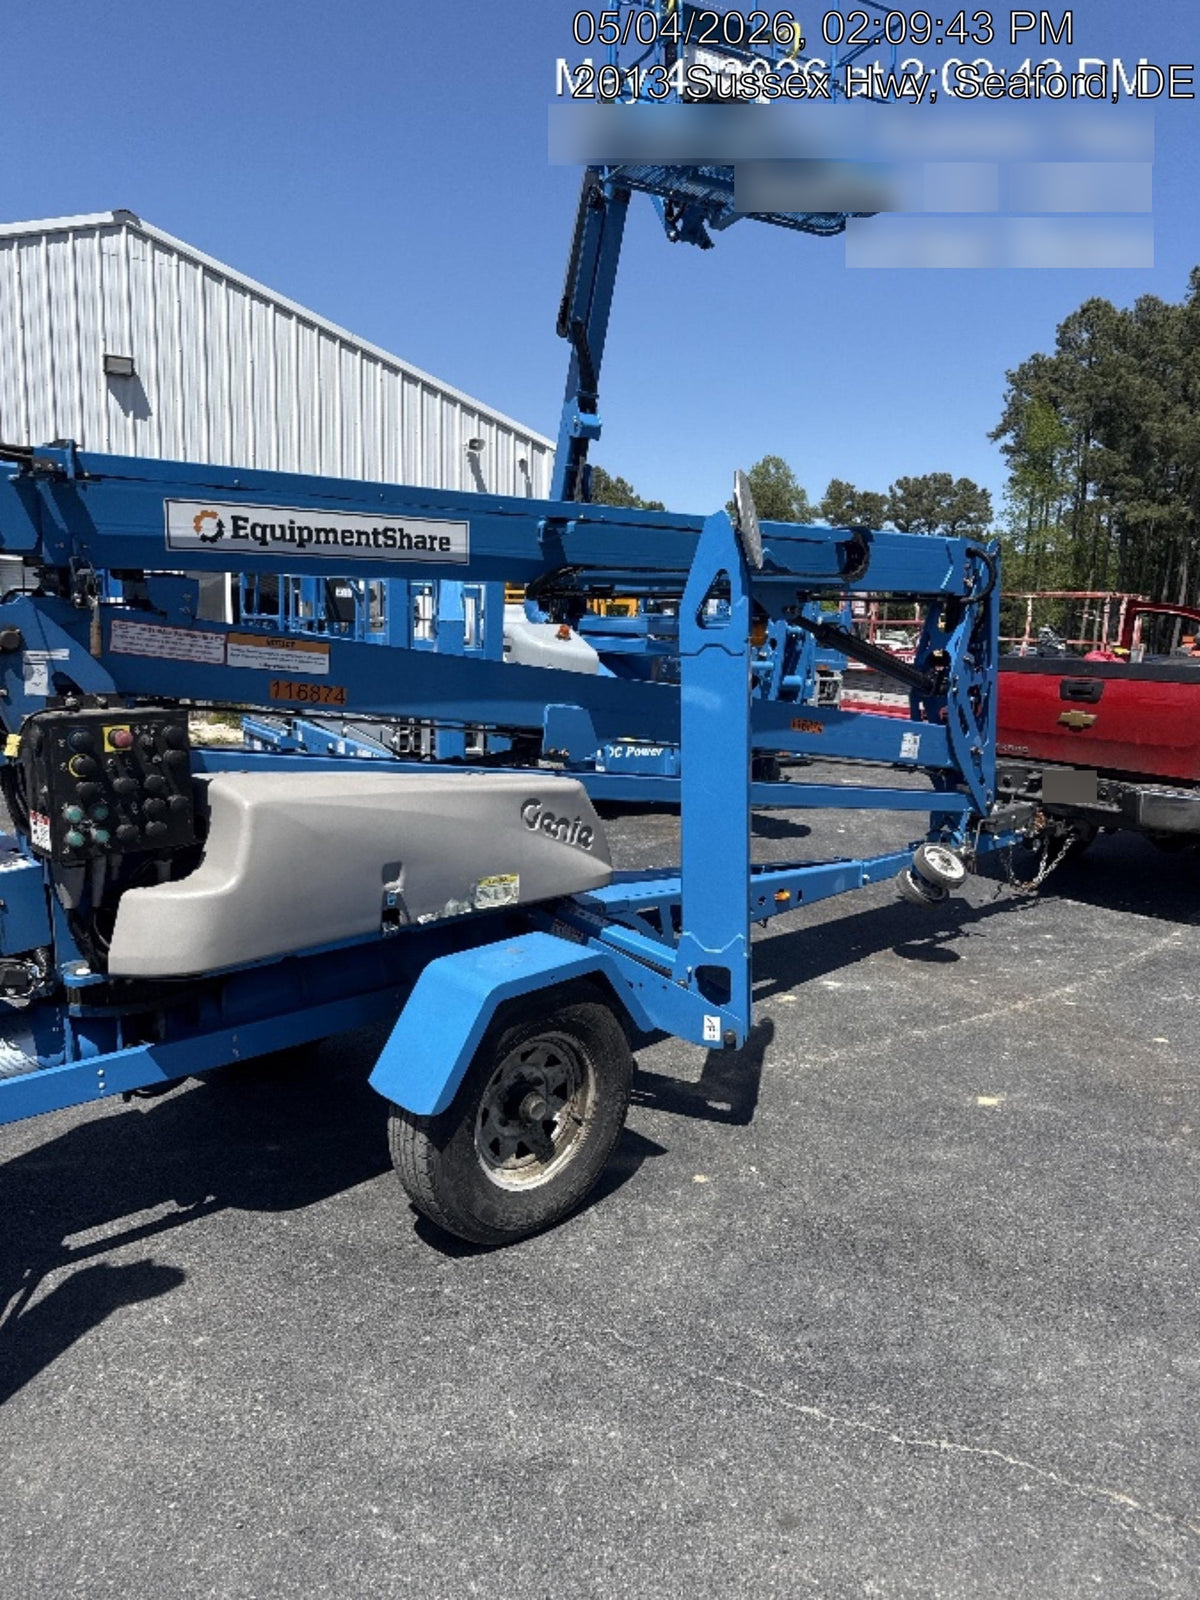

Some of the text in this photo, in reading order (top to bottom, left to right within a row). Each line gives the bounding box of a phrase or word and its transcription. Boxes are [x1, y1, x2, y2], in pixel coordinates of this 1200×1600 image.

[230, 514, 451, 551] EquipmentShare
[271, 679, 346, 704] 116874
[625, 746, 664, 758] Power
[520, 798, 595, 850] Genie
